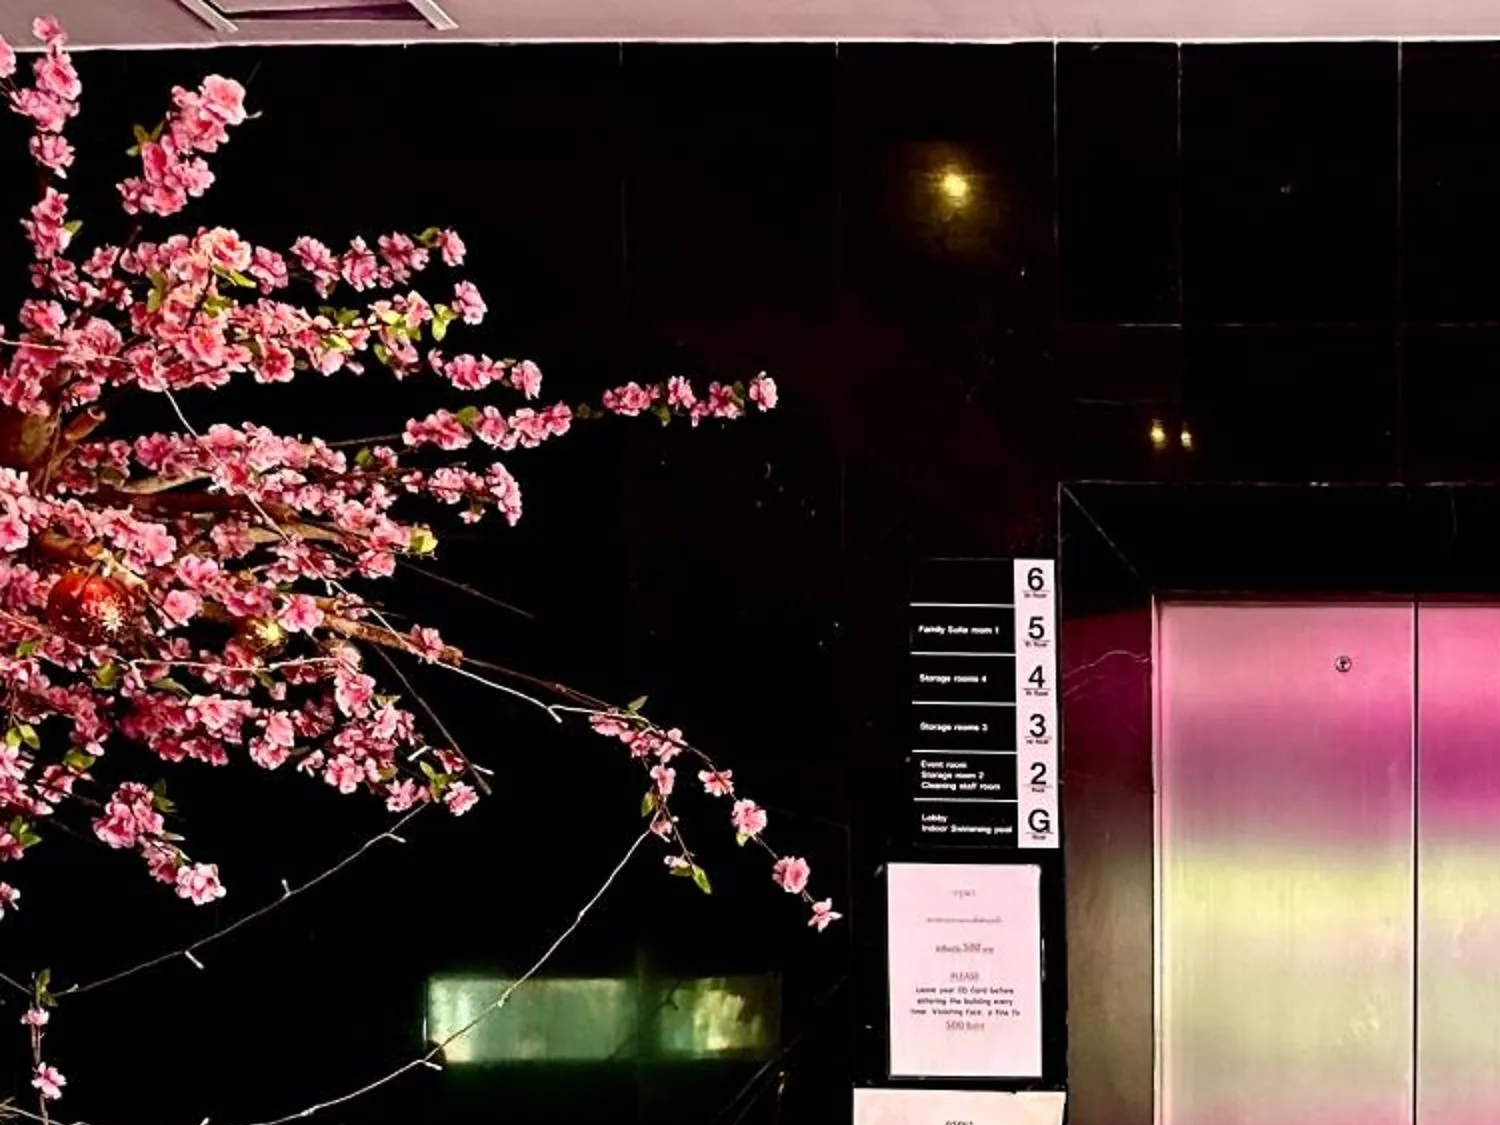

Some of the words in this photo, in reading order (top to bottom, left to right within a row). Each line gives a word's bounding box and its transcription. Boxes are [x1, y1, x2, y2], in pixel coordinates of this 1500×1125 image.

[1027, 567, 1045, 591] 6
[918, 625, 946, 635] Family
[1028, 616, 1045, 640] 5
[919, 673, 951, 684] Storage
[981, 675, 987, 683] 4
[1028, 665, 1046, 688] 4
[920, 722, 952, 733] Storage
[982, 723, 988, 732] 3
[1029, 713, 1046, 738] 3
[921, 760, 944, 769] Event
[946, 761, 967, 769] room
[921, 771, 952, 780] Storage
[1030, 762, 1047, 785] 2
[921, 782, 956, 791] Cleaning
[959, 782, 977, 790] staff
[980, 783, 1001, 791] room
[922, 813, 948, 823] Lobby
[1028, 808, 1051, 833] G
[922, 824, 948, 833] Indoor
[964, 997, 991, 1006] building
